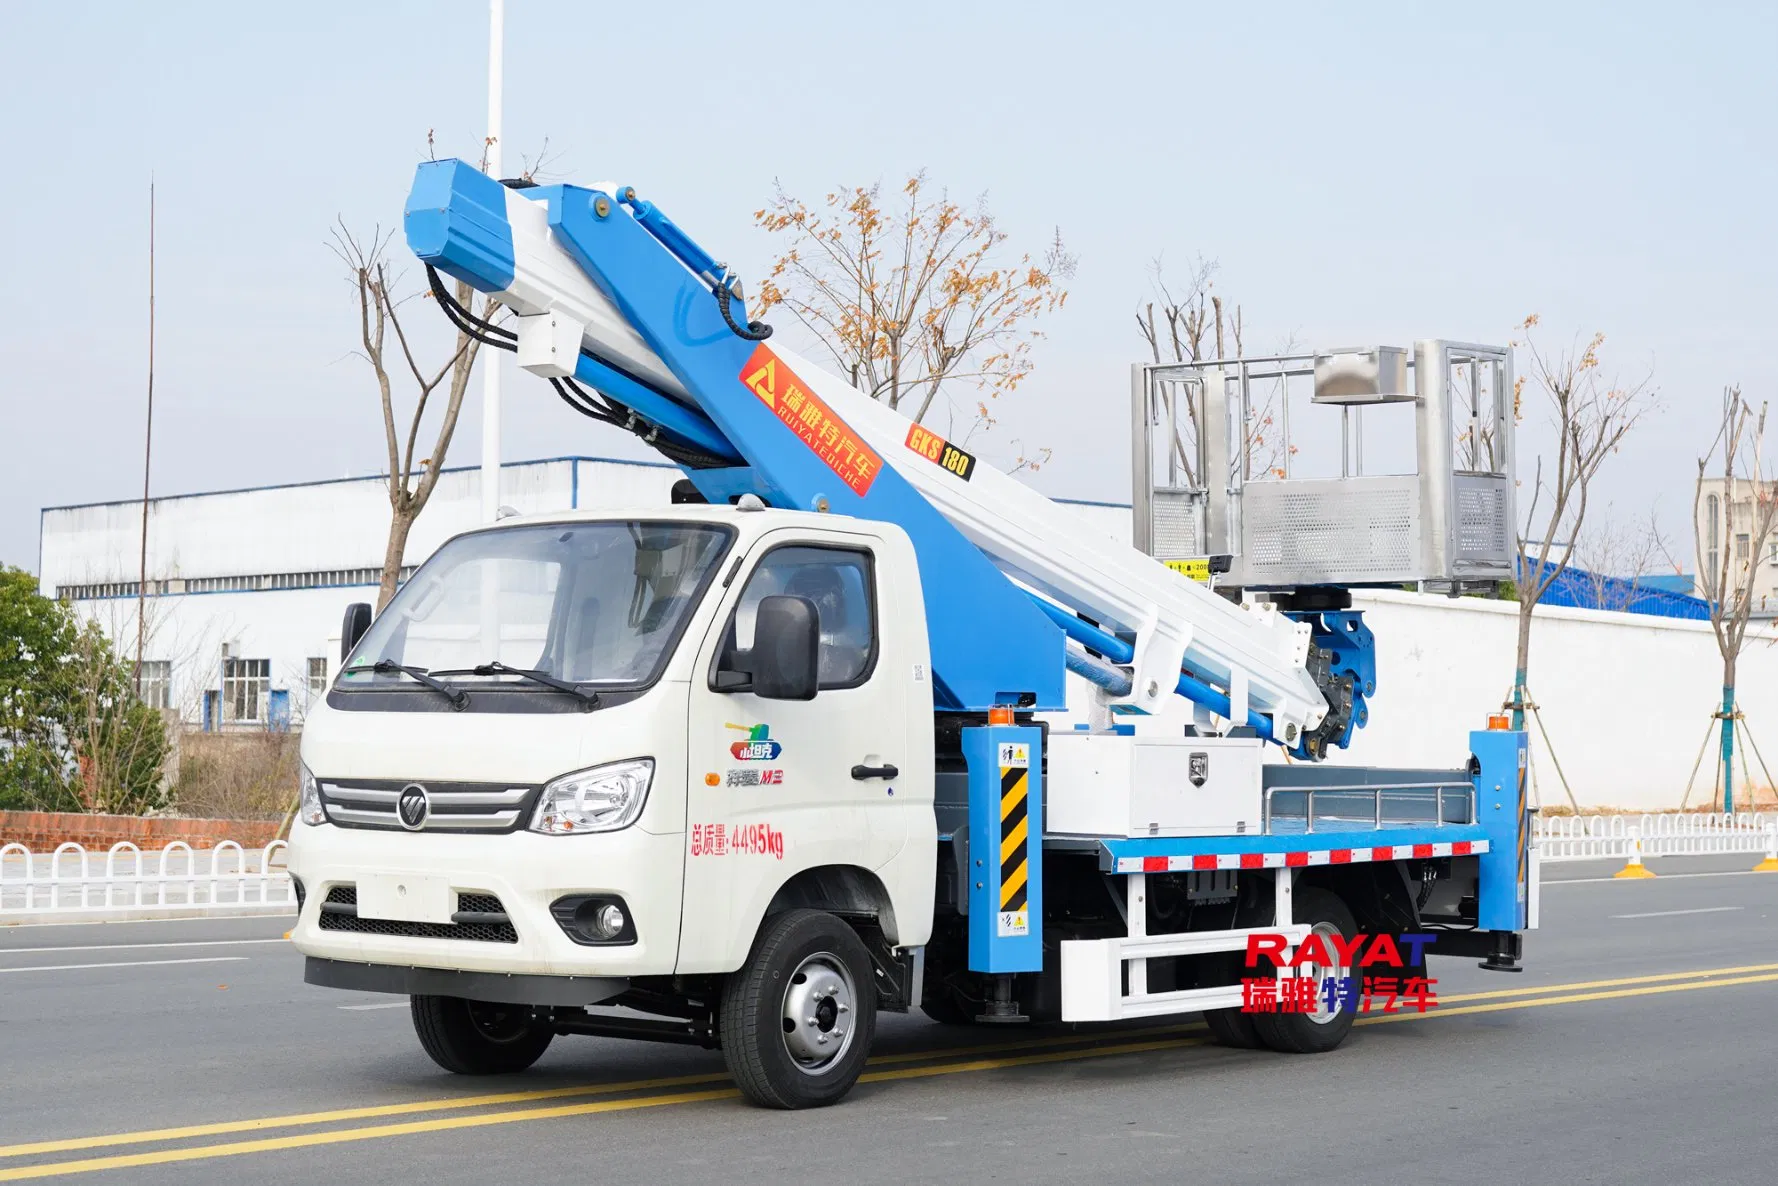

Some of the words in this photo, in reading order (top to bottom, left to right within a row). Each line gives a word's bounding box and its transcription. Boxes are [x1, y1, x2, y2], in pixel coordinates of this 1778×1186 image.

[778, 406, 866, 489] RUIYATEQICHE
[781, 384, 880, 480] 瑞雅特汽车
[910, 429, 941, 460] GKS
[942, 447, 969, 476] 180
[739, 742, 773, 759] 小坦克
